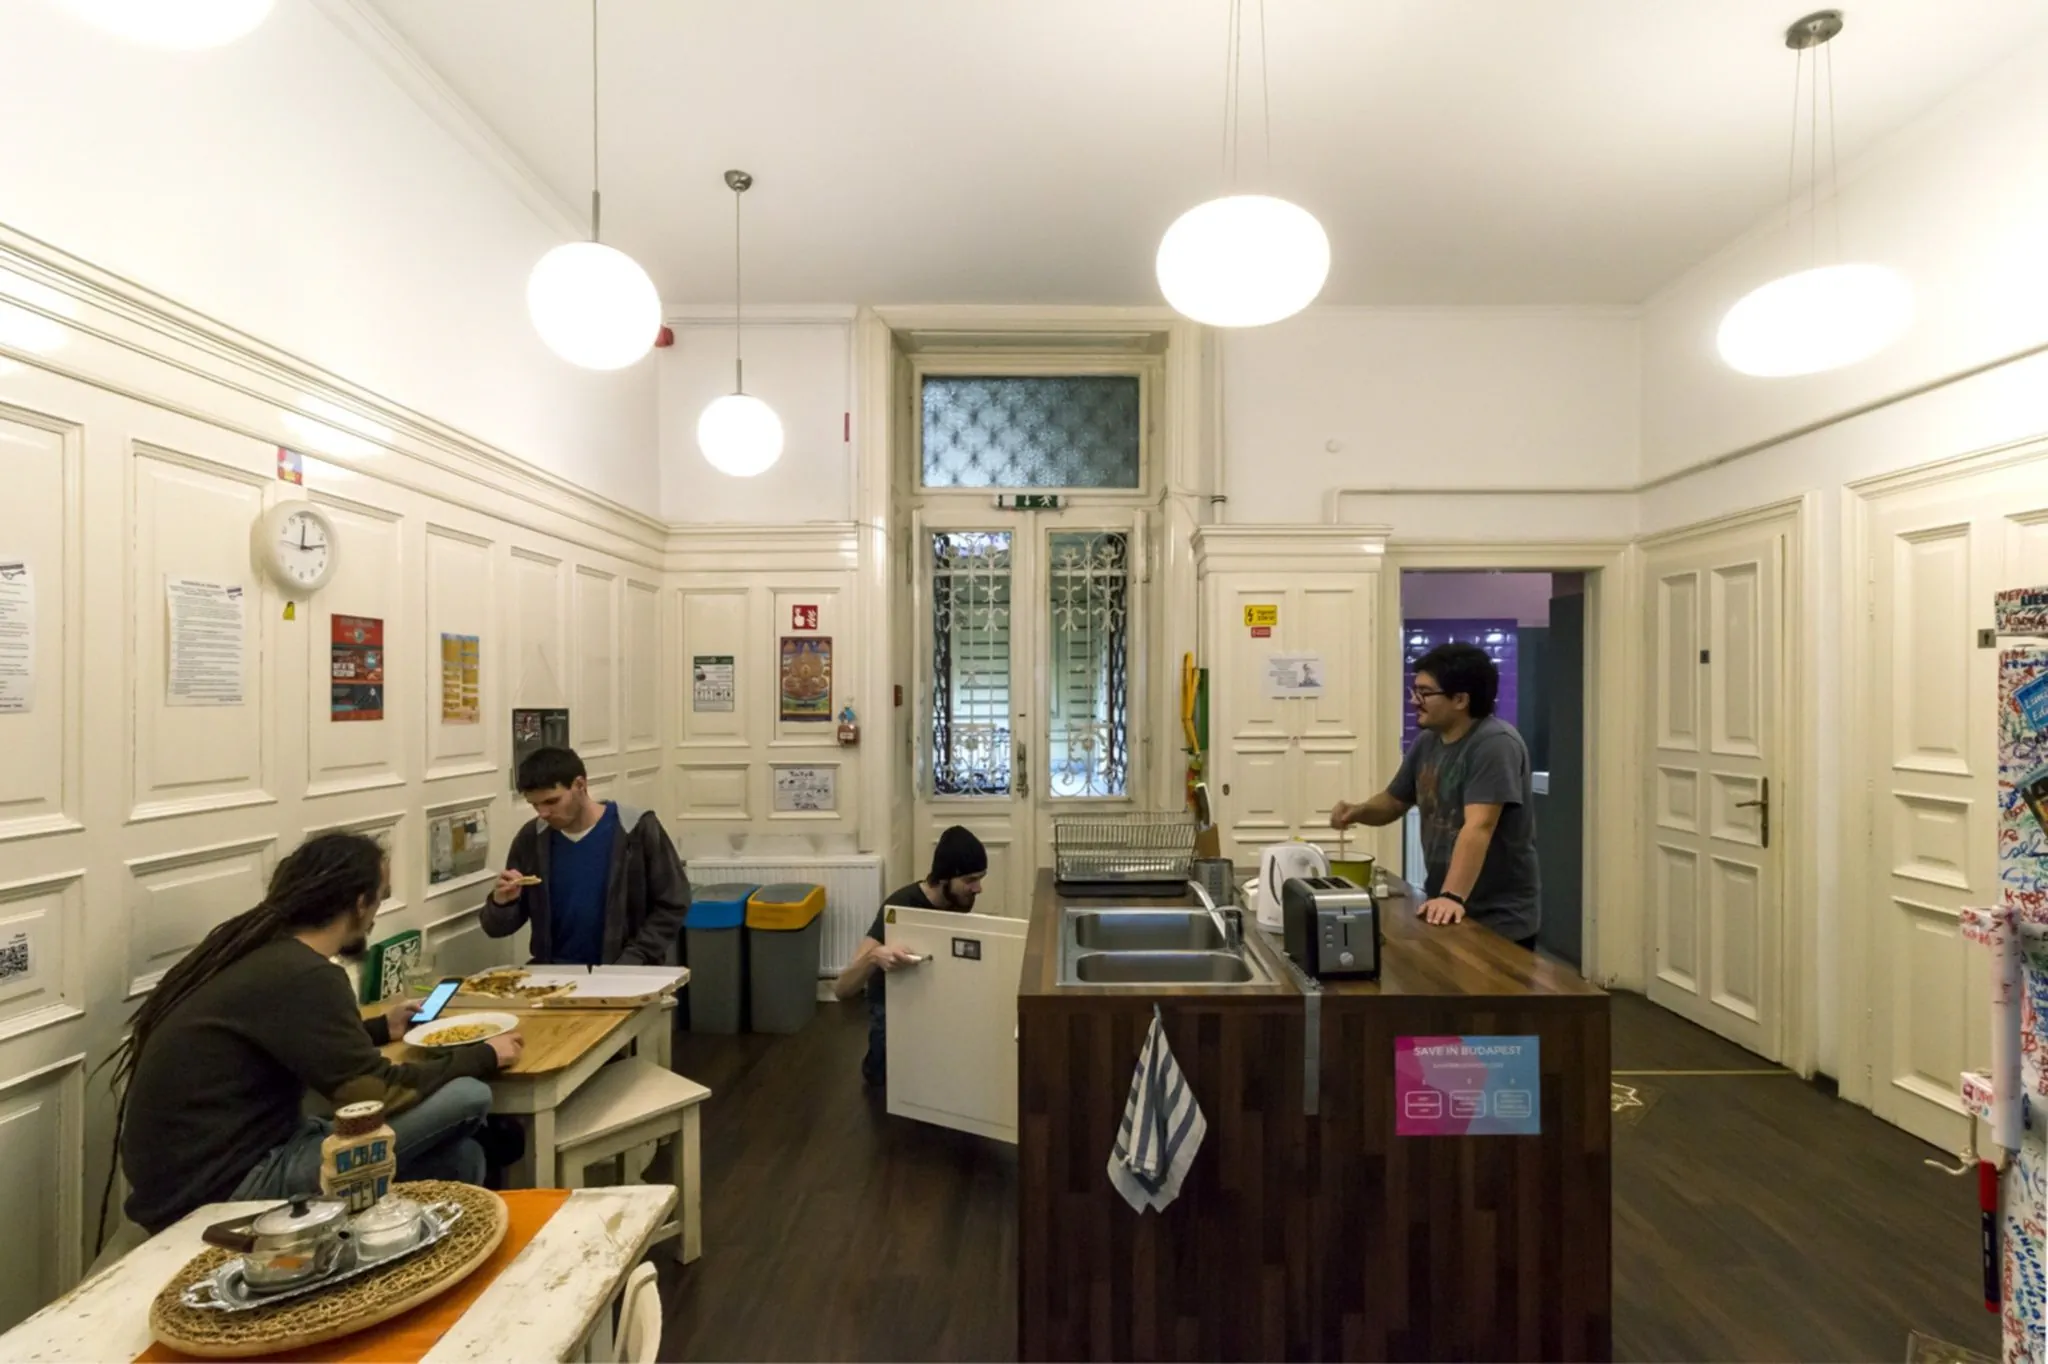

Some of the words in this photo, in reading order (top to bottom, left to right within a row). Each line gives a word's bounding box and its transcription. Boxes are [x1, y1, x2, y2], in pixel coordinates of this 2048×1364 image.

[1413, 1045, 1443, 1057] SAVE
[1445, 1045, 1458, 1056] IN
[1461, 1045, 1522, 1056] BUDAPEST
